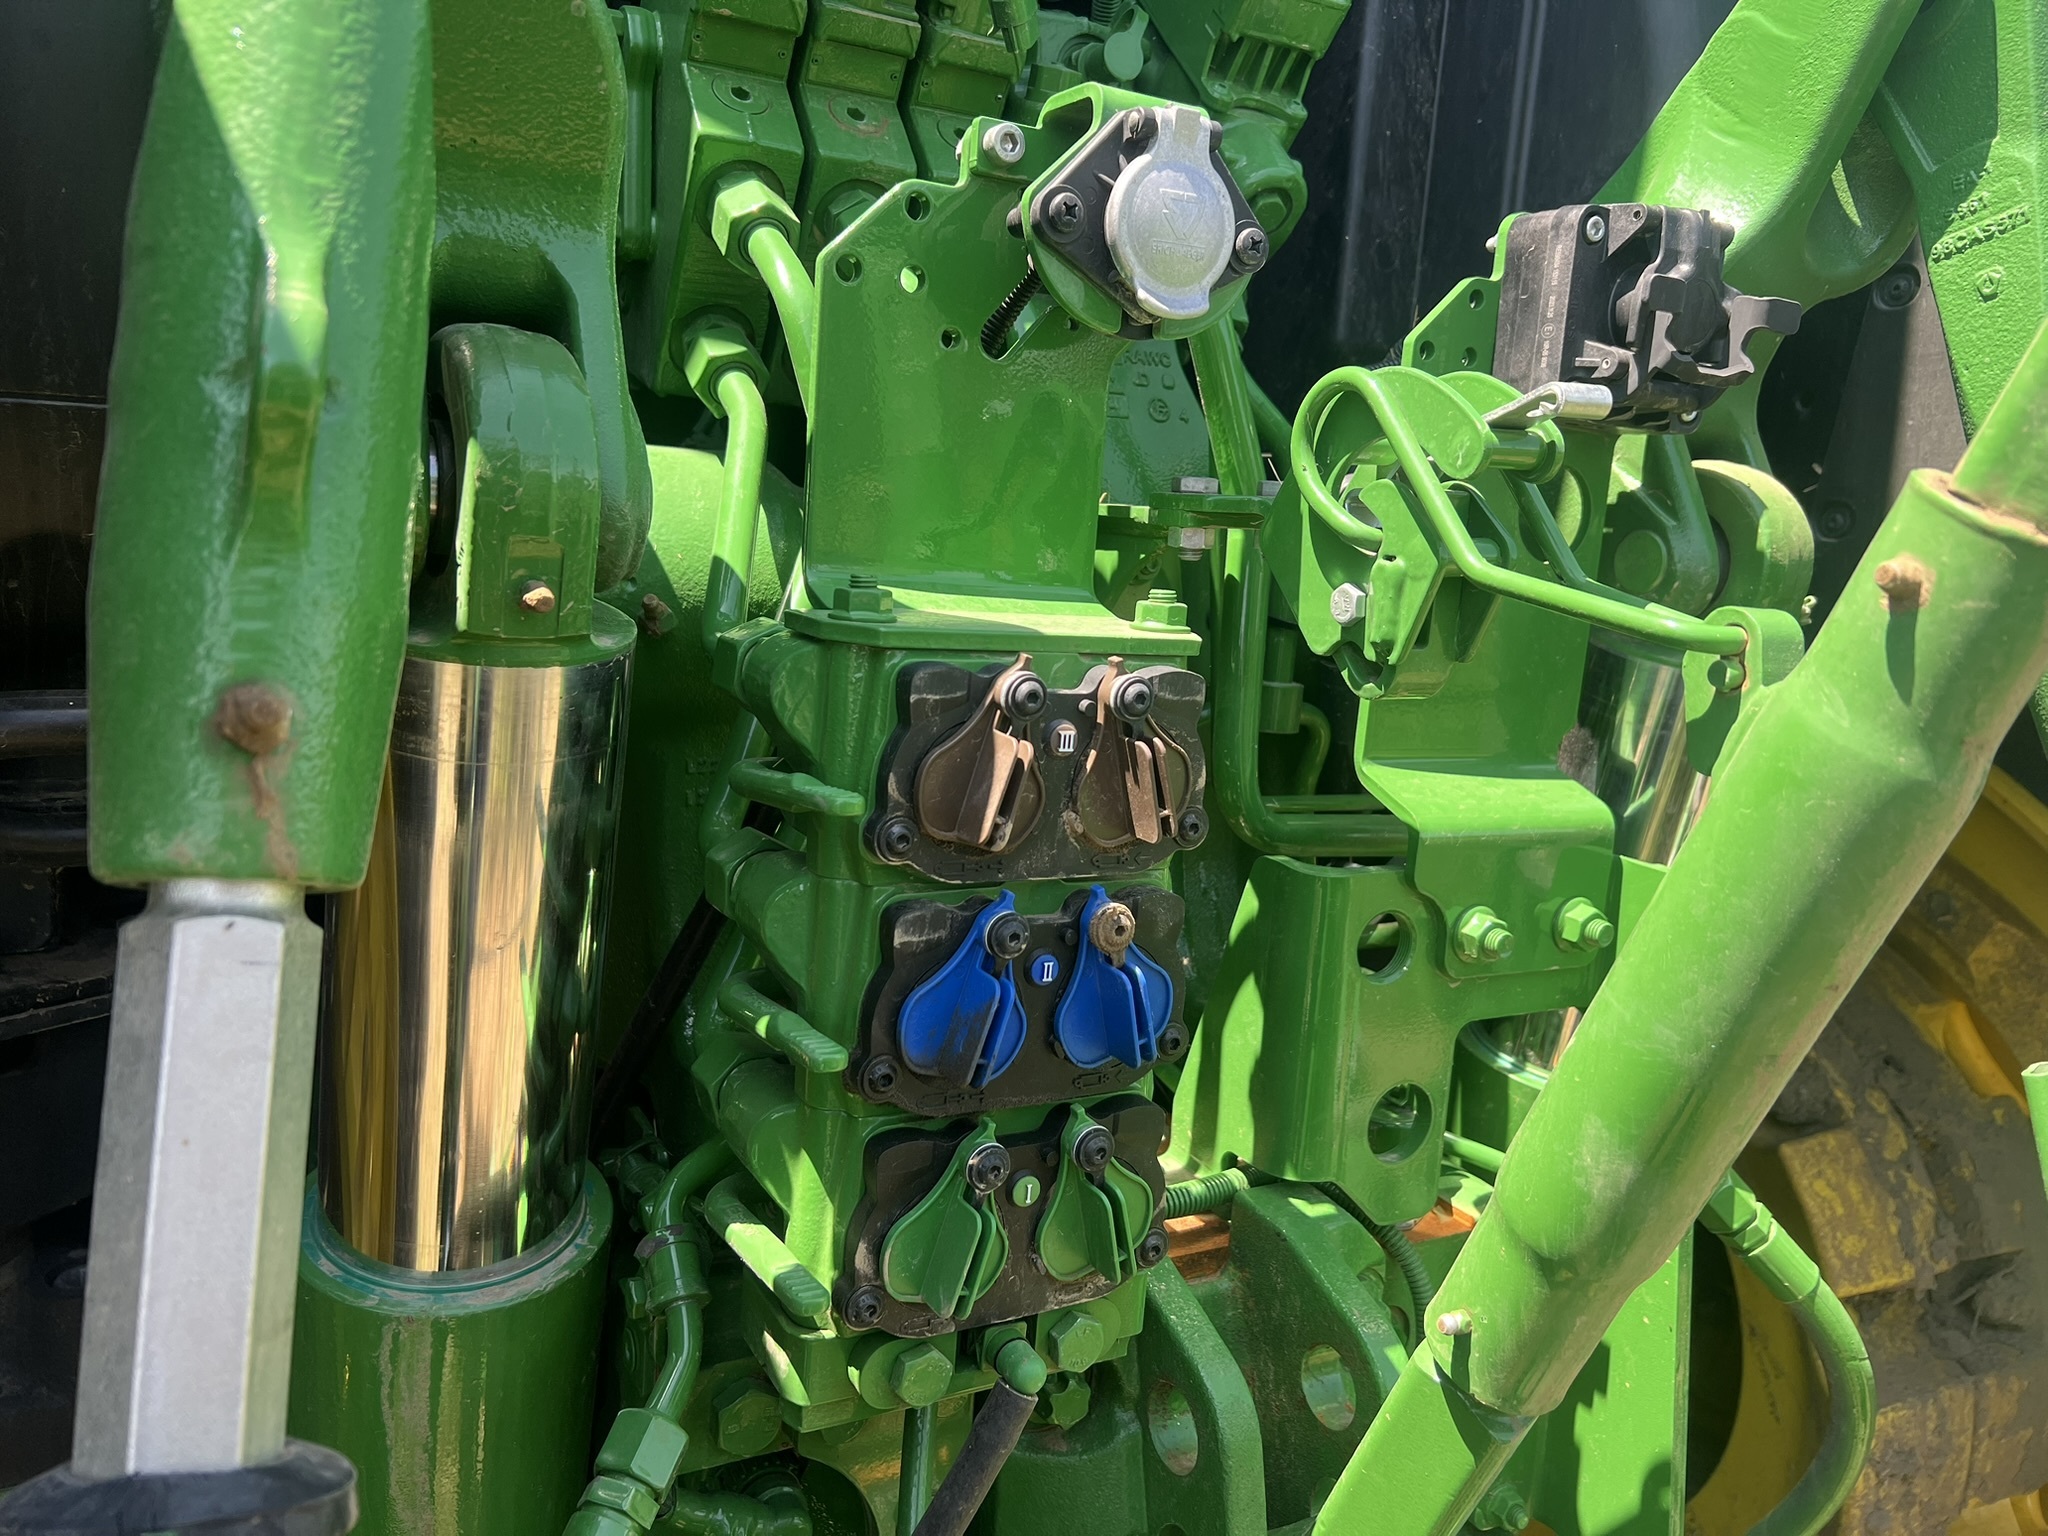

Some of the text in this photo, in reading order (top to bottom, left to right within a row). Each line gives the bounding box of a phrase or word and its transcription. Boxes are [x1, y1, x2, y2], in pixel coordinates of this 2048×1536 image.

[1058, 730, 1077, 752] III
[1042, 961, 1054, 983] II
[1025, 1183, 1033, 1204] I
